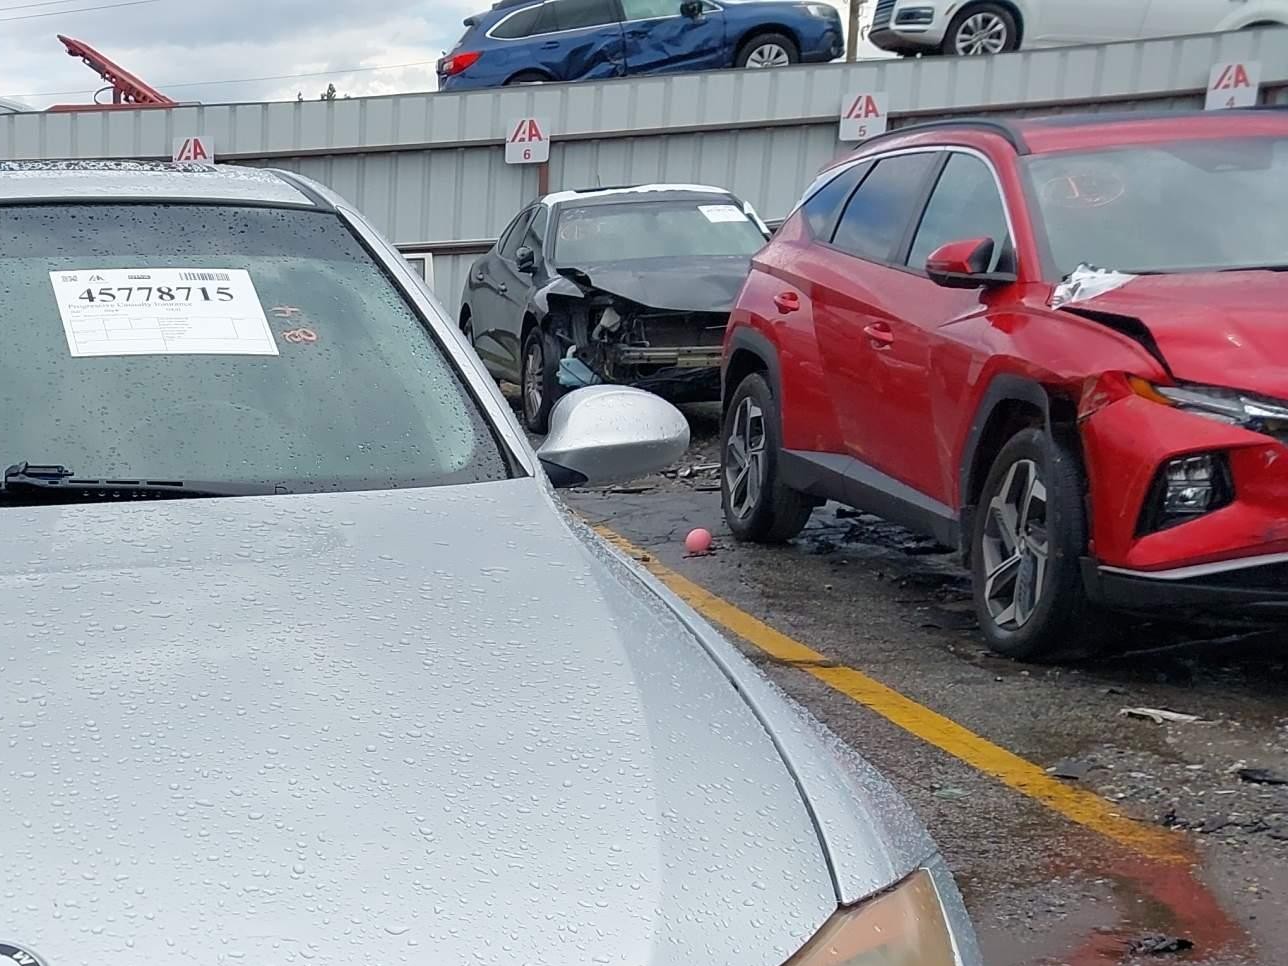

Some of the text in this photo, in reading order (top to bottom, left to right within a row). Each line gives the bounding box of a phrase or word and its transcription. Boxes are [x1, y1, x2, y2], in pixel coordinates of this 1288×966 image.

[859, 125, 867, 137] 5
[523, 149, 532, 160] 6
[78, 286, 234, 302] 45778715
